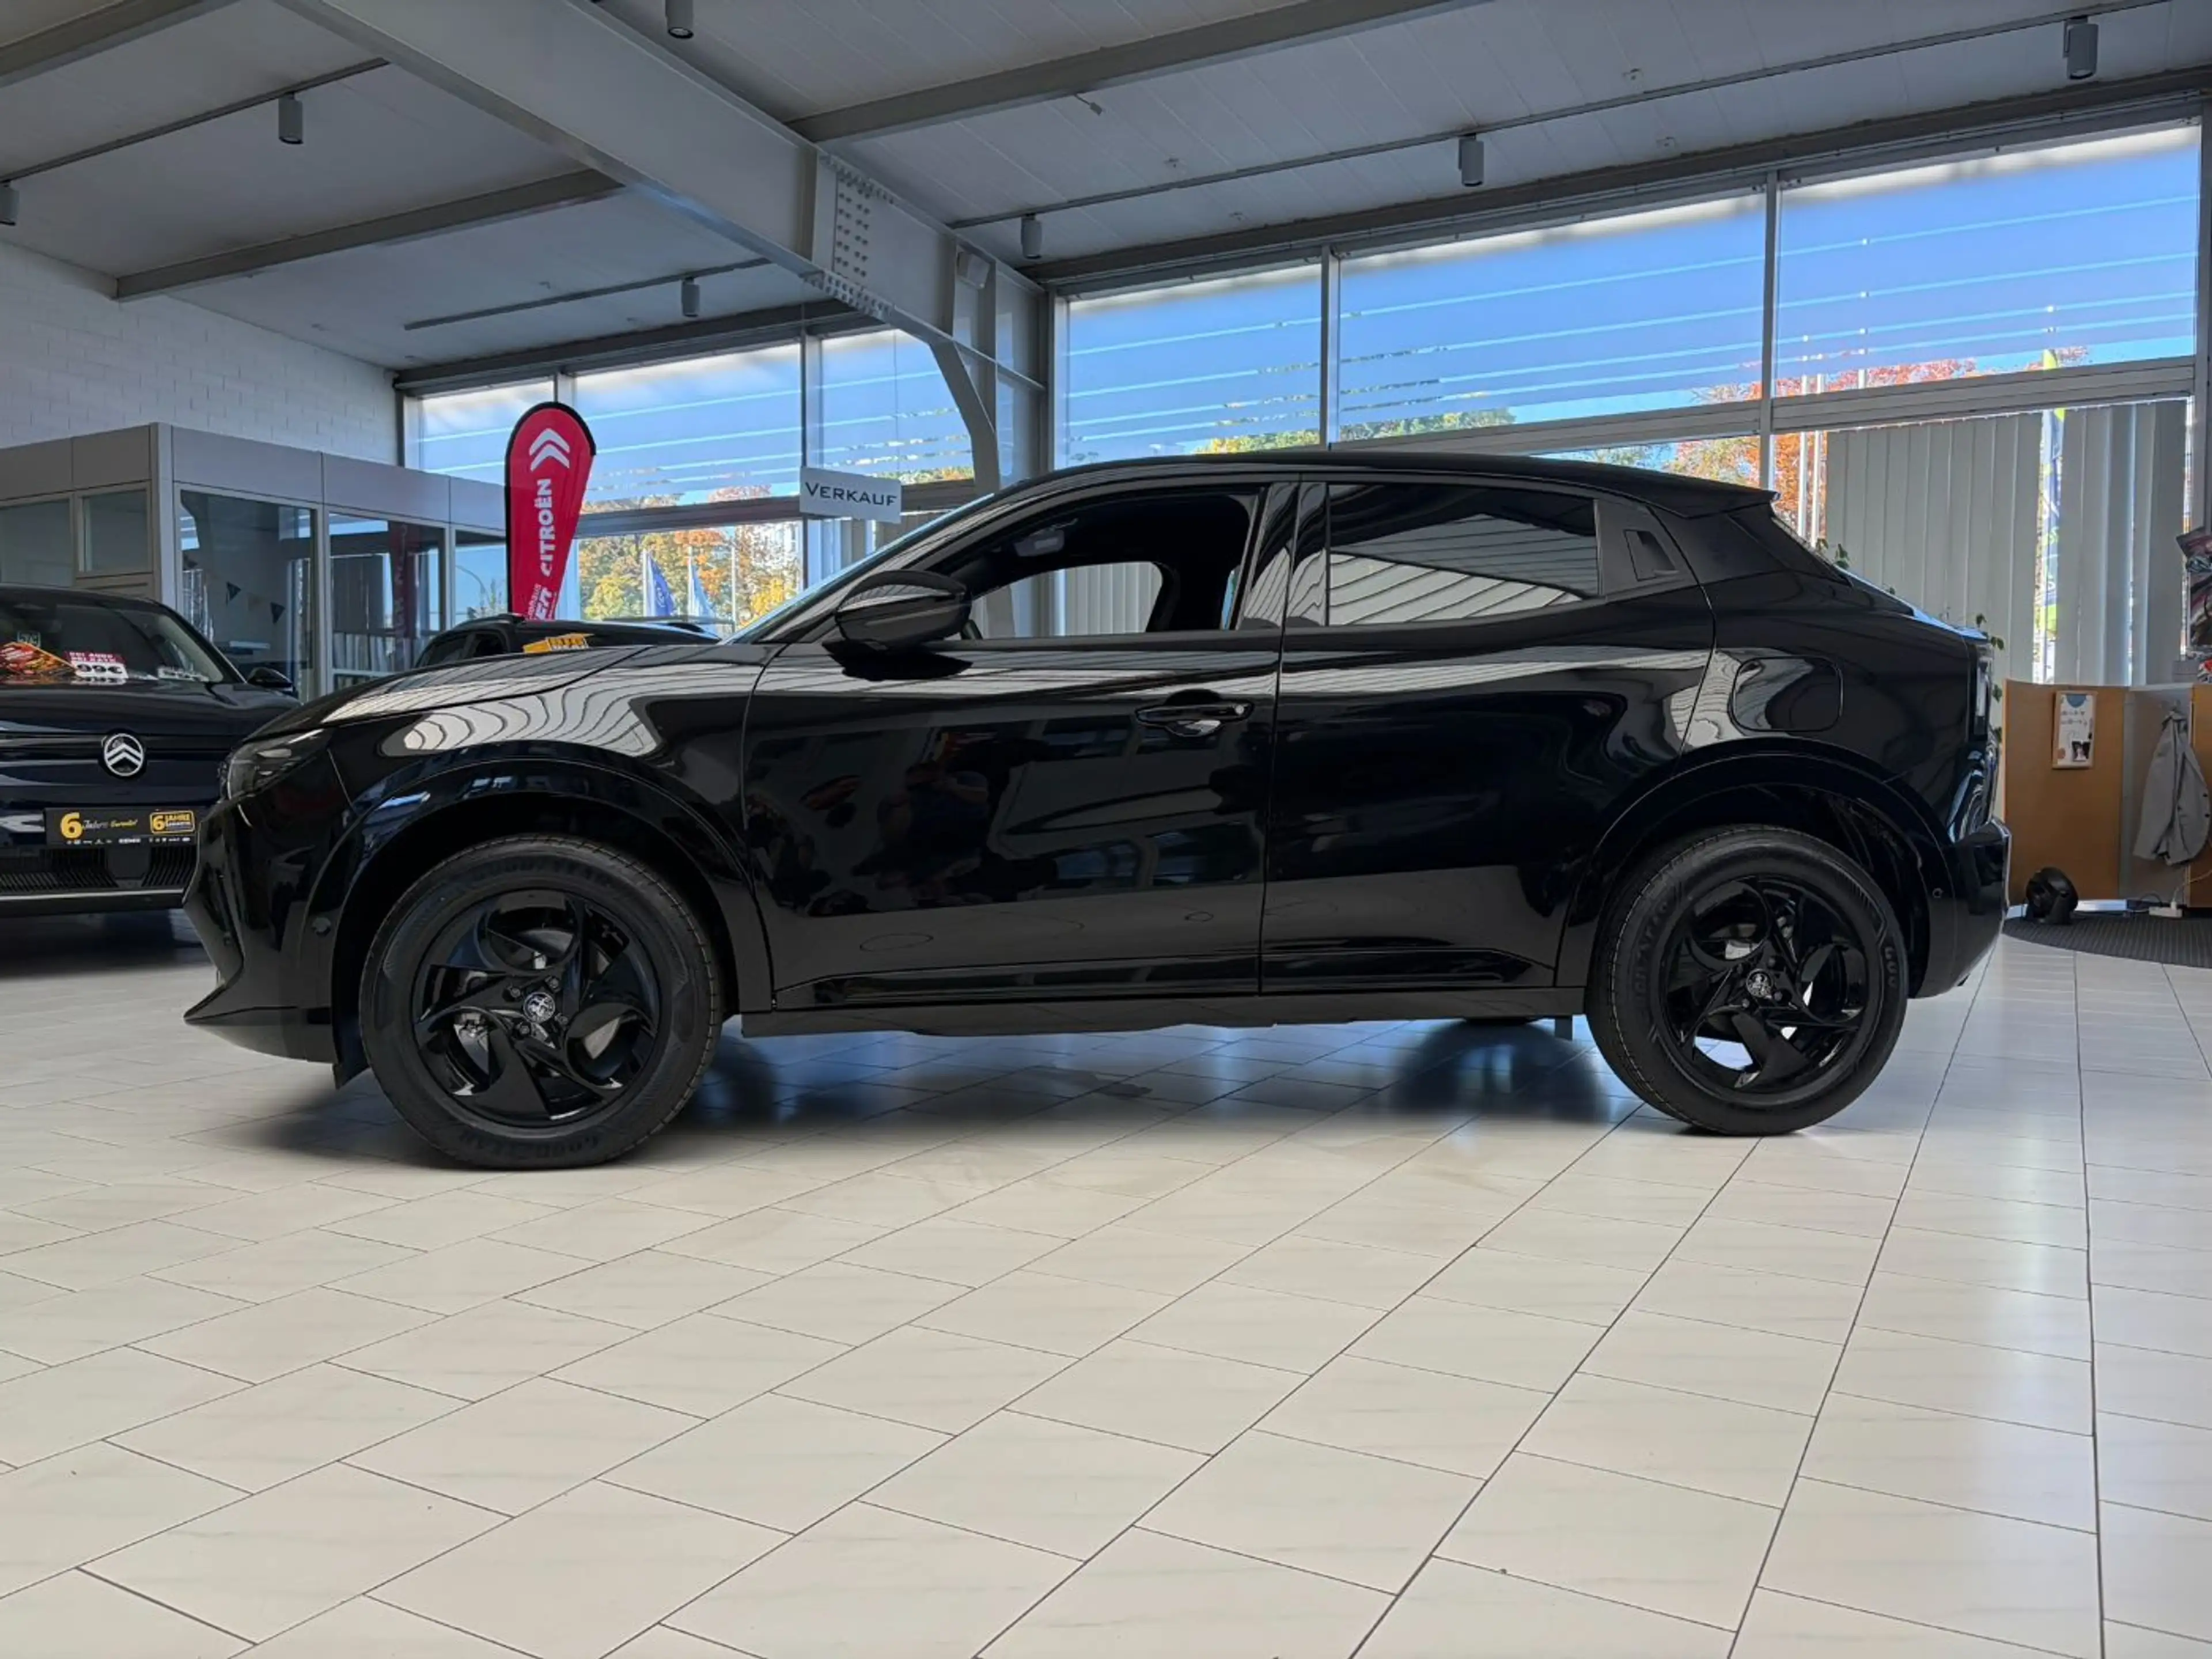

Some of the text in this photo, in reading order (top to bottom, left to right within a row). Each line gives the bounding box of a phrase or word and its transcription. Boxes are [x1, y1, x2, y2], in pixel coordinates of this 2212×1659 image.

[805, 482, 897, 506] VERKAUF
[535, 479, 556, 577] CITROËN
[60, 812, 83, 839] 6
[153, 815, 165, 830] 6
